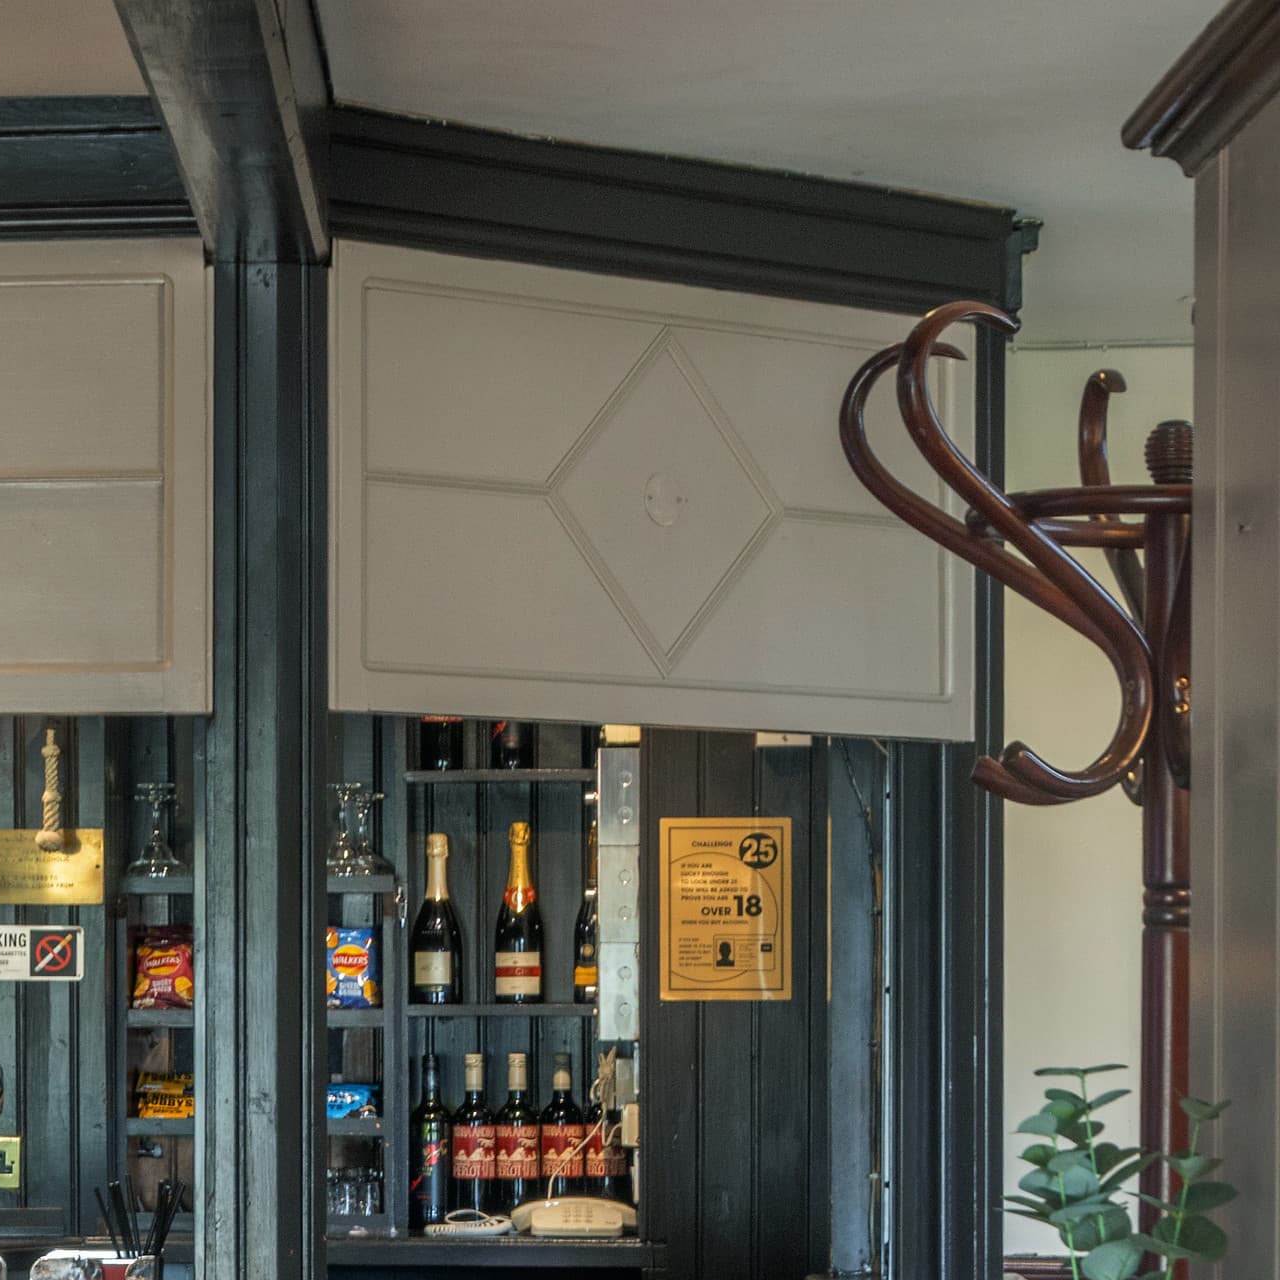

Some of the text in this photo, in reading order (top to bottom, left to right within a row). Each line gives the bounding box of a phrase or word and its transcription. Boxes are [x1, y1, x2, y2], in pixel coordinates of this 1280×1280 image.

[742, 838, 775, 862] 25
[701, 894, 762, 917] OVER 18
